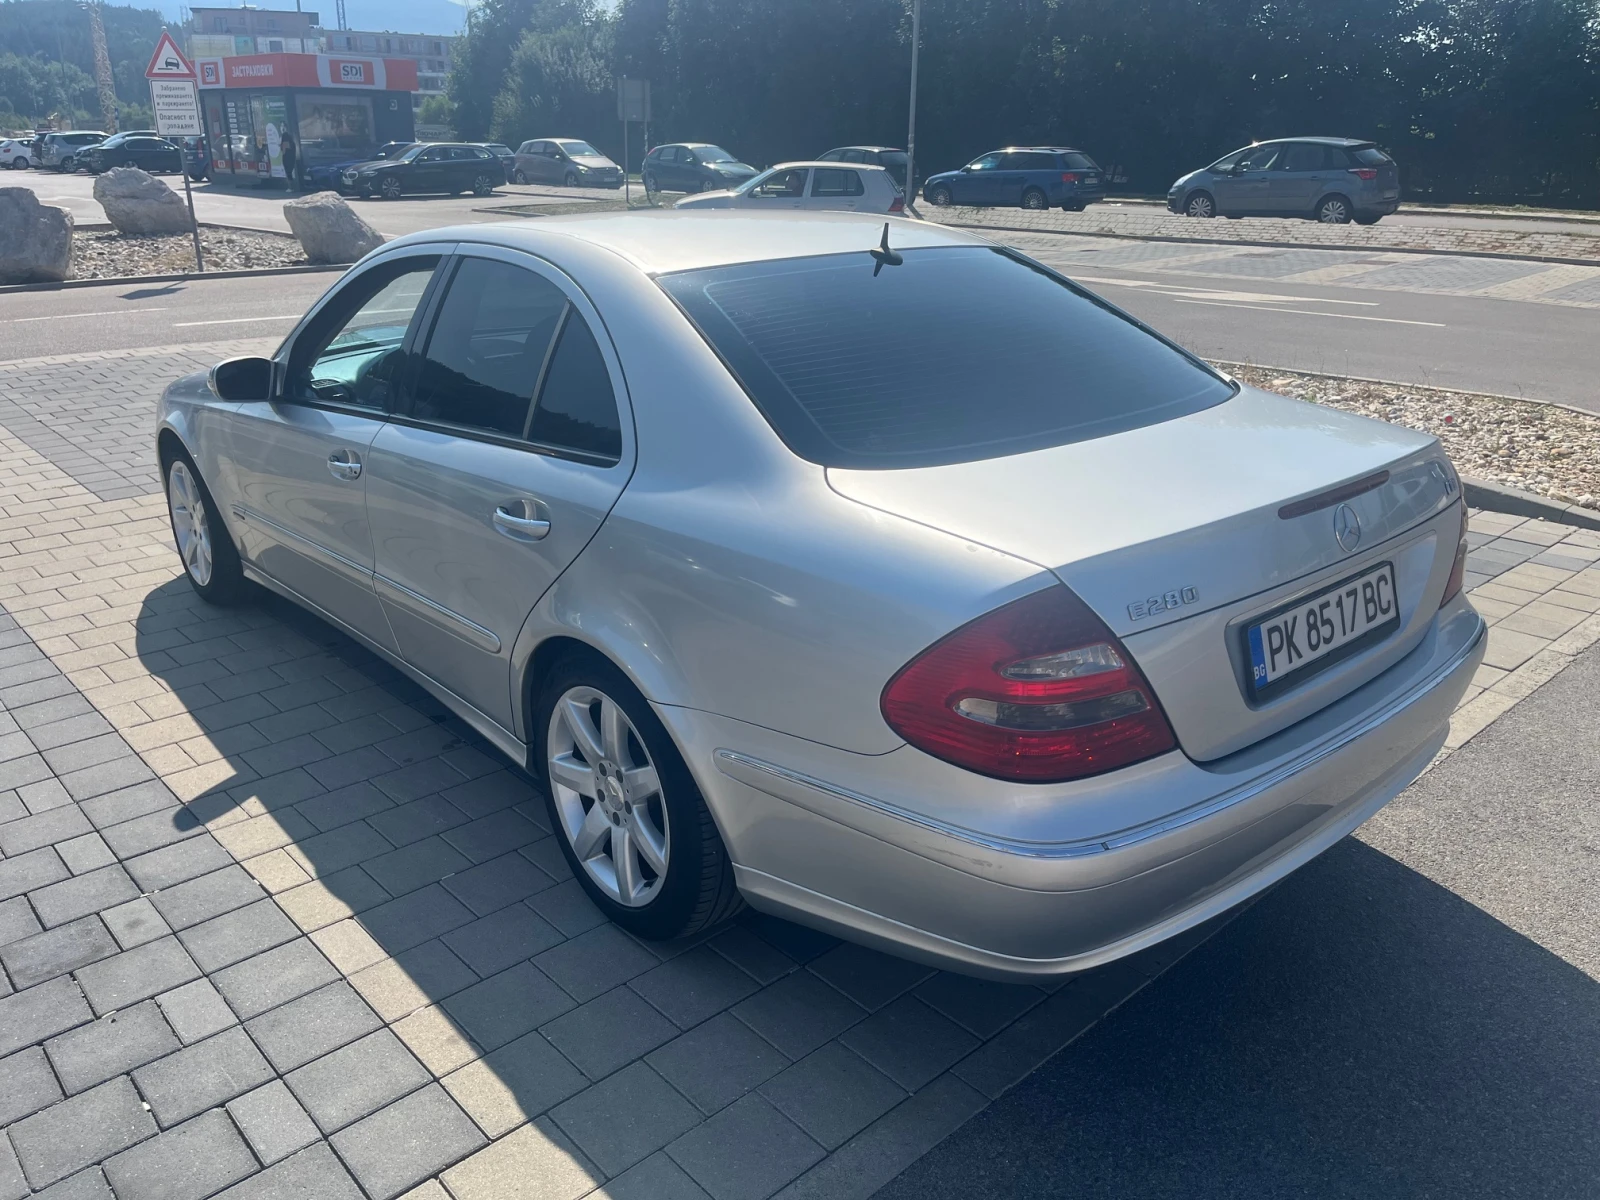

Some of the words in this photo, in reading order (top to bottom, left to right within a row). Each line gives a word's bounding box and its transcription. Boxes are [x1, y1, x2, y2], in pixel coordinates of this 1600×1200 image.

[205, 67, 215, 77] SDI
[232, 64, 273, 77] ЗАСТРАХОВКИ
[342, 65, 362, 77] SDI
[1267, 615, 1303, 672] PK
[1306, 588, 1358, 652] 8517
[1362, 574, 1391, 624] BC
[1253, 663, 1266, 680] BG
